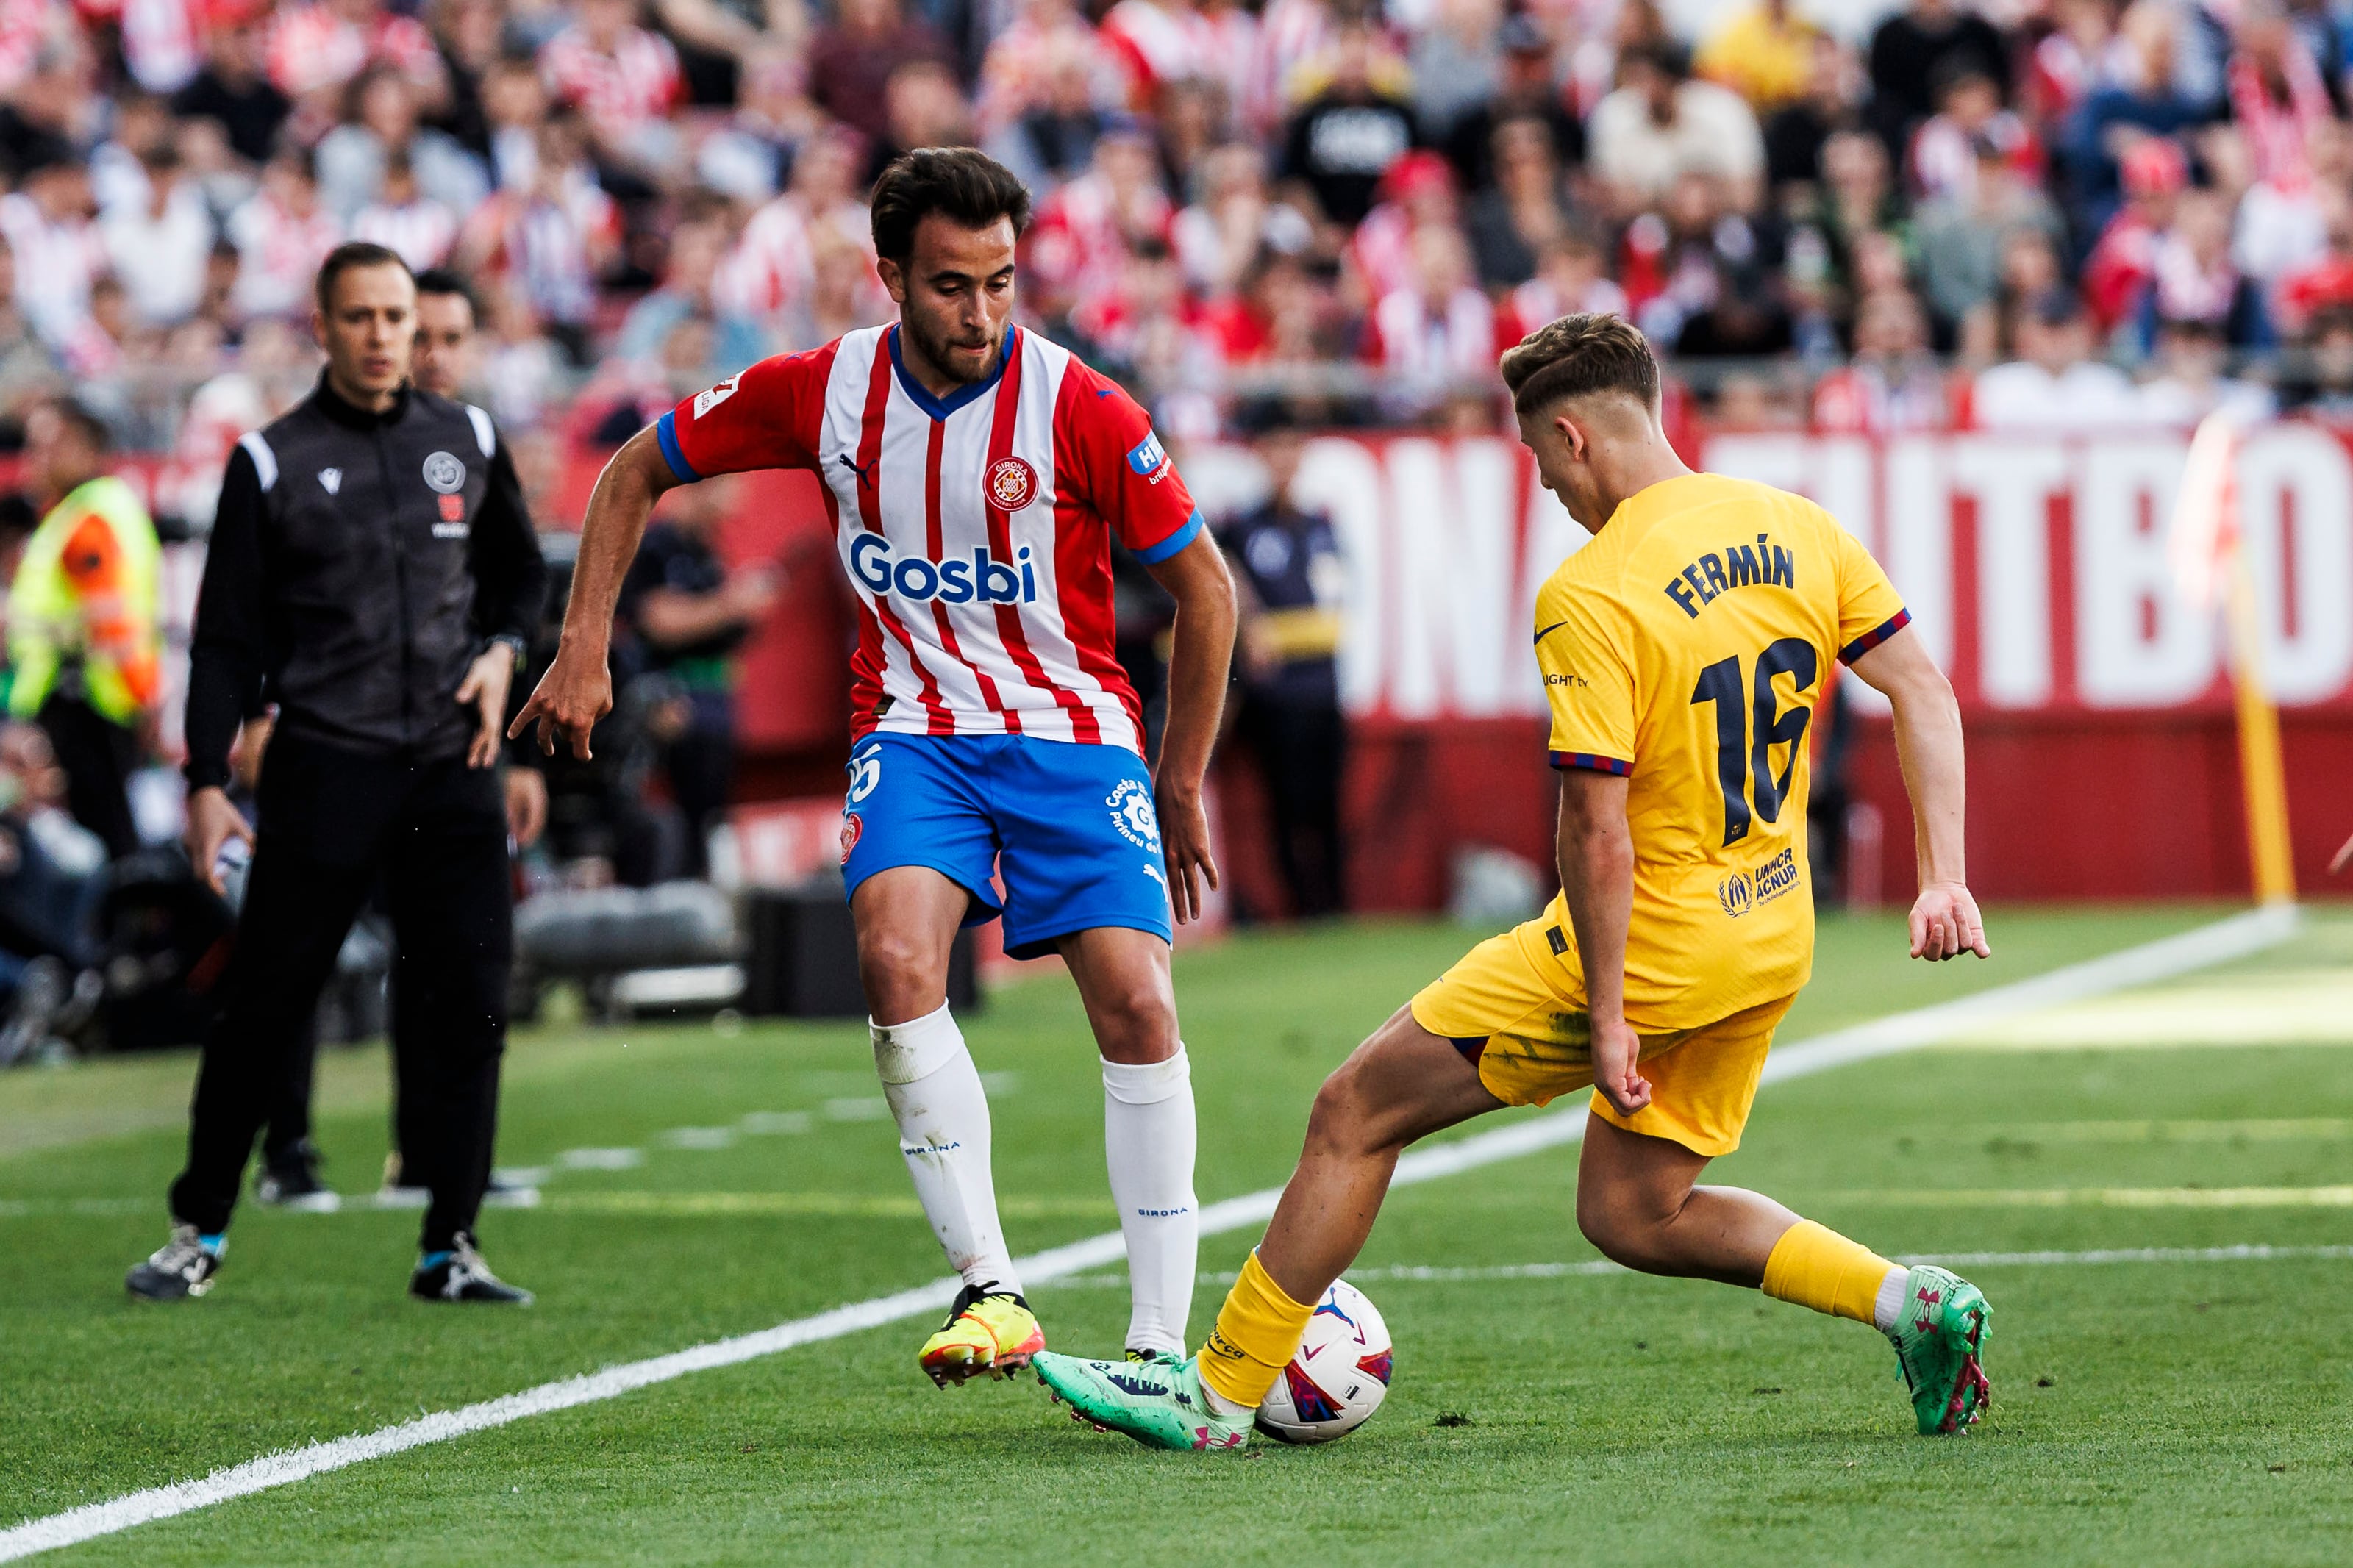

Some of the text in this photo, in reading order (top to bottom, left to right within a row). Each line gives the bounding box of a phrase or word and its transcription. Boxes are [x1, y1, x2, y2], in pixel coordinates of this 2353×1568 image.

[995, 461, 1028, 476] GIRONA
[851, 533, 1037, 604] Gosbi
[1663, 533, 1794, 620] FERMÍN
[1690, 637, 1818, 848] 16
[1105, 778, 1138, 807] Costa
[1109, 811, 1144, 848] Pirineu
[1755, 847, 1793, 883] UNHCR
[1756, 864, 1798, 901] ACNUR
[905, 1142, 960, 1155] GIRONA
[1138, 1207, 1188, 1217] GIRONA
